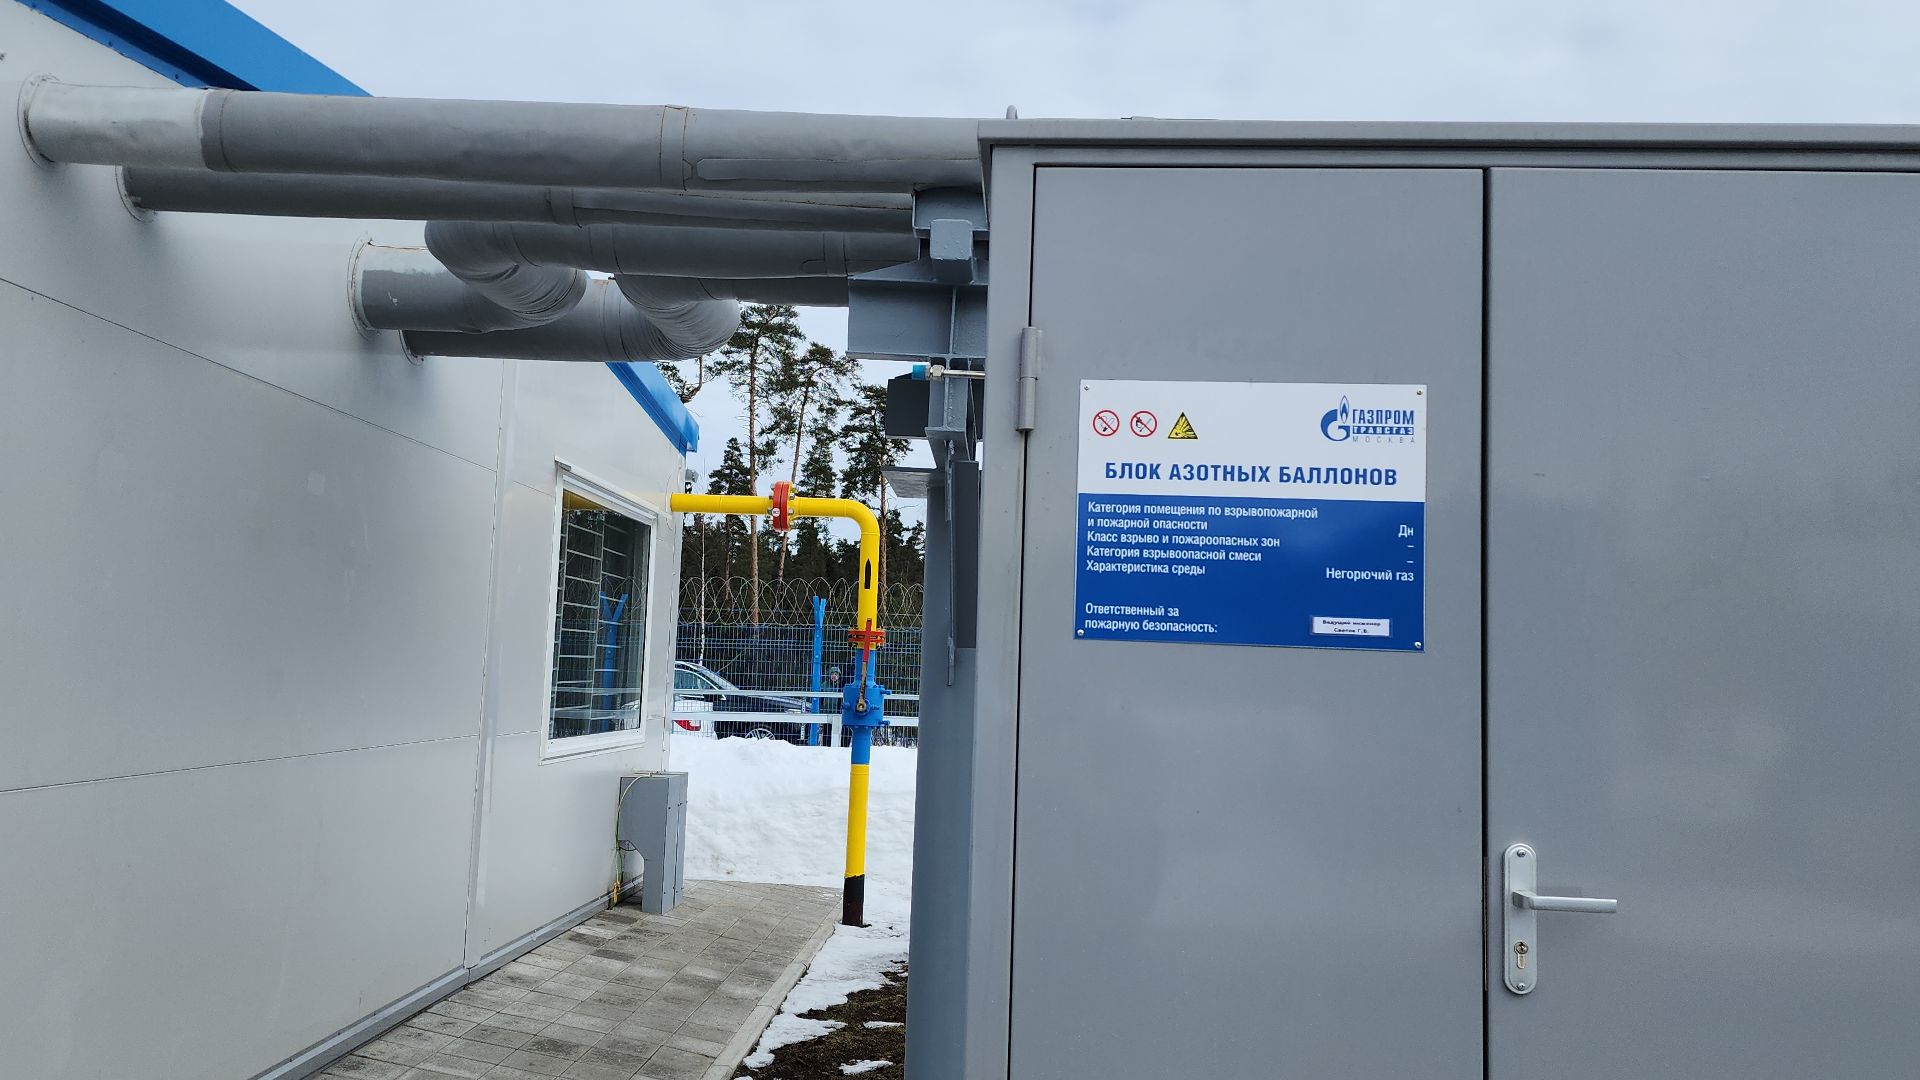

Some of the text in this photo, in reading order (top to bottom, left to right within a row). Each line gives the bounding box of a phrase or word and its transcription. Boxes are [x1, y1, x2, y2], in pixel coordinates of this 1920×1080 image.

[1352, 409, 1415, 425] ГАЗПРОМ
[1352, 426, 1414, 435] ТРАНСГАЗ
[1352, 436, 1415, 444] МОСКВА
[1105, 462, 1398, 487] БЛОК АЗОТНЫХ БАЛЛОНОВ
[1088, 501, 1318, 520] Категория помещения по взрывопожарной
[1087, 517, 1208, 531] и пожарной опасности
[1398, 524, 1414, 538] Дн
[1087, 531, 1280, 548] Класс взрыво и пожароопасных зон
[1086, 545, 1262, 562] Категория взрывоопасной смеси
[1086, 560, 1206, 576] Характеристика среды
[1326, 567, 1414, 582] Негорючий газ
[1085, 602, 1180, 617] Ответственный за
[1085, 618, 1218, 633] пожарную безопасность:
